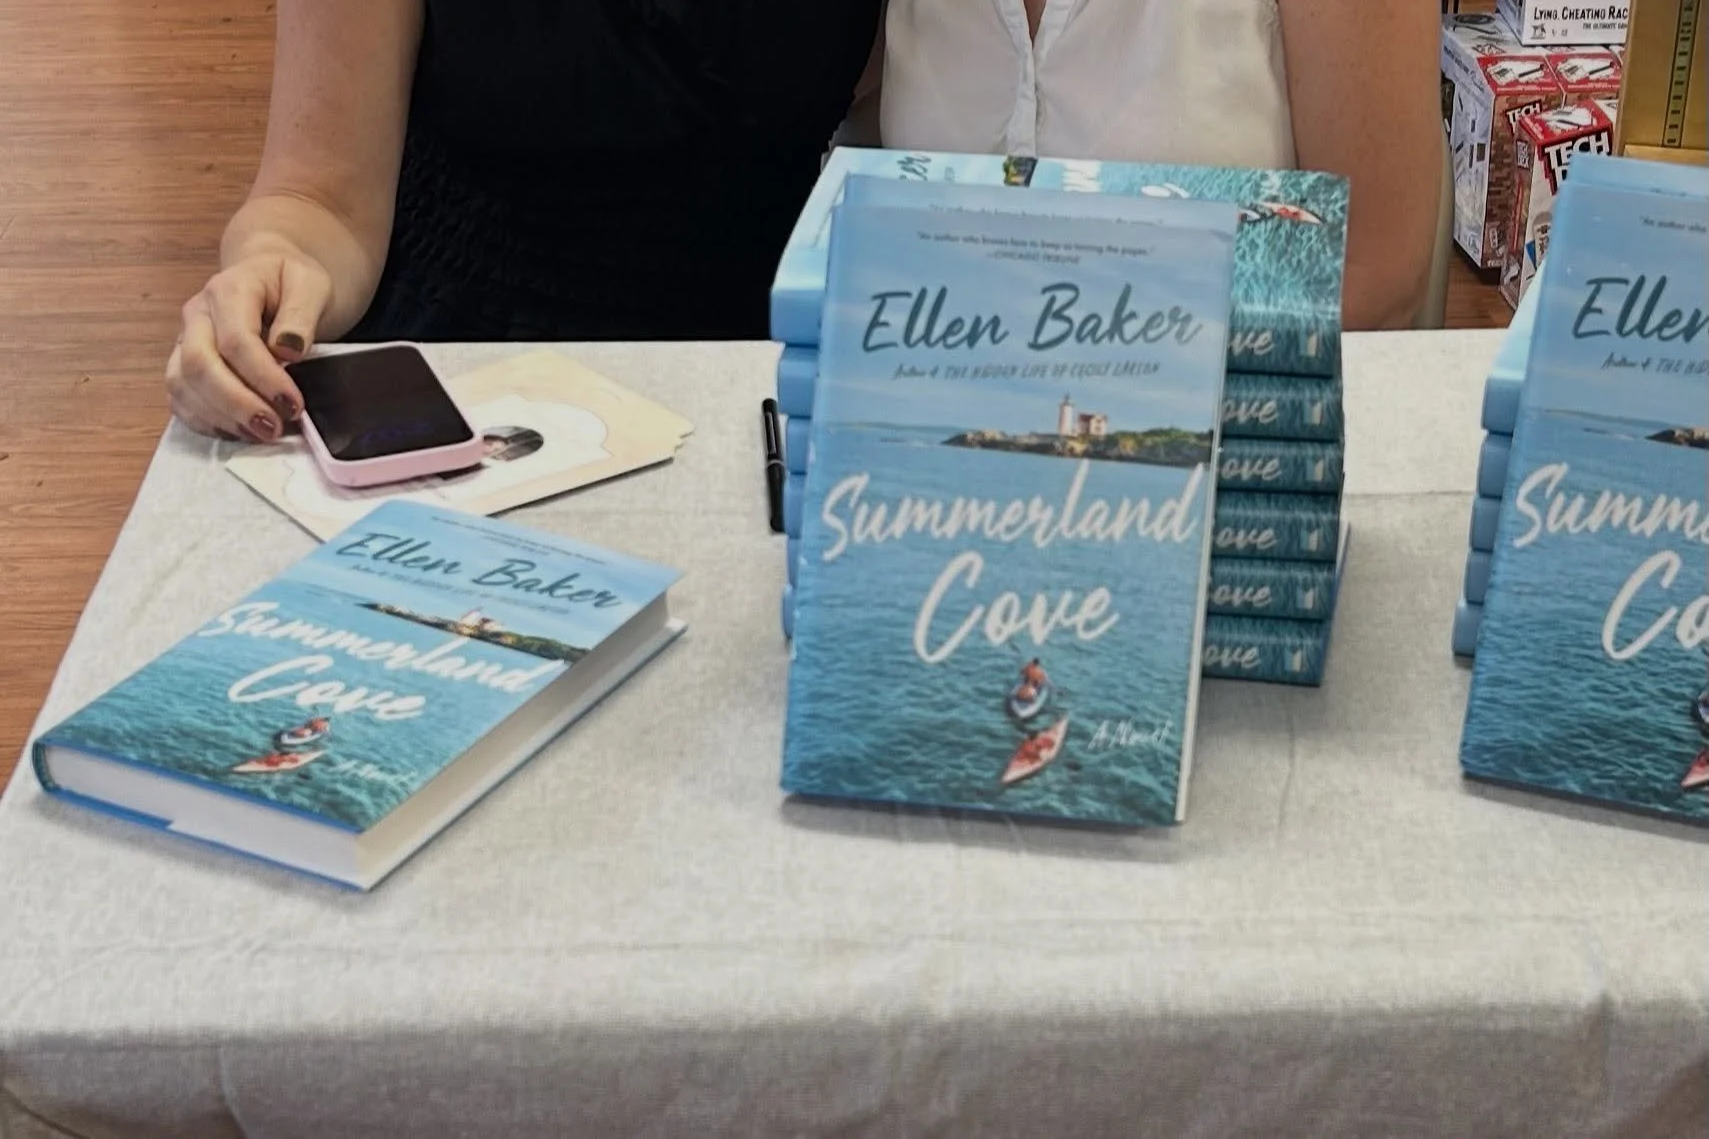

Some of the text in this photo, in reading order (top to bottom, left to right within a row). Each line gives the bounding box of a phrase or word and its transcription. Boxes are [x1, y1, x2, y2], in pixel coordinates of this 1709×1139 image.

[1608, 5, 1628, 19] RAC
[1545, 131, 1610, 170] TECH
[862, 282, 1204, 354] Ellen Baker
[1228, 330, 1275, 355] ve
[1221, 399, 1280, 424] ove
[1219, 458, 1282, 481] ove
[822, 458, 1204, 562] Summerland
[1513, 462, 1709, 548] Summ
[1213, 527, 1279, 550] ove
[336, 532, 461, 575] Ellen
[472, 558, 622, 608] Baker
[1211, 584, 1273, 608] ove
[913, 550, 1121, 663] Cove
[1602, 549, 1709, 660] Co
[198, 601, 569, 693] Summerland
[1203, 644, 1262, 669] ove
[228, 654, 427, 721] Cove
